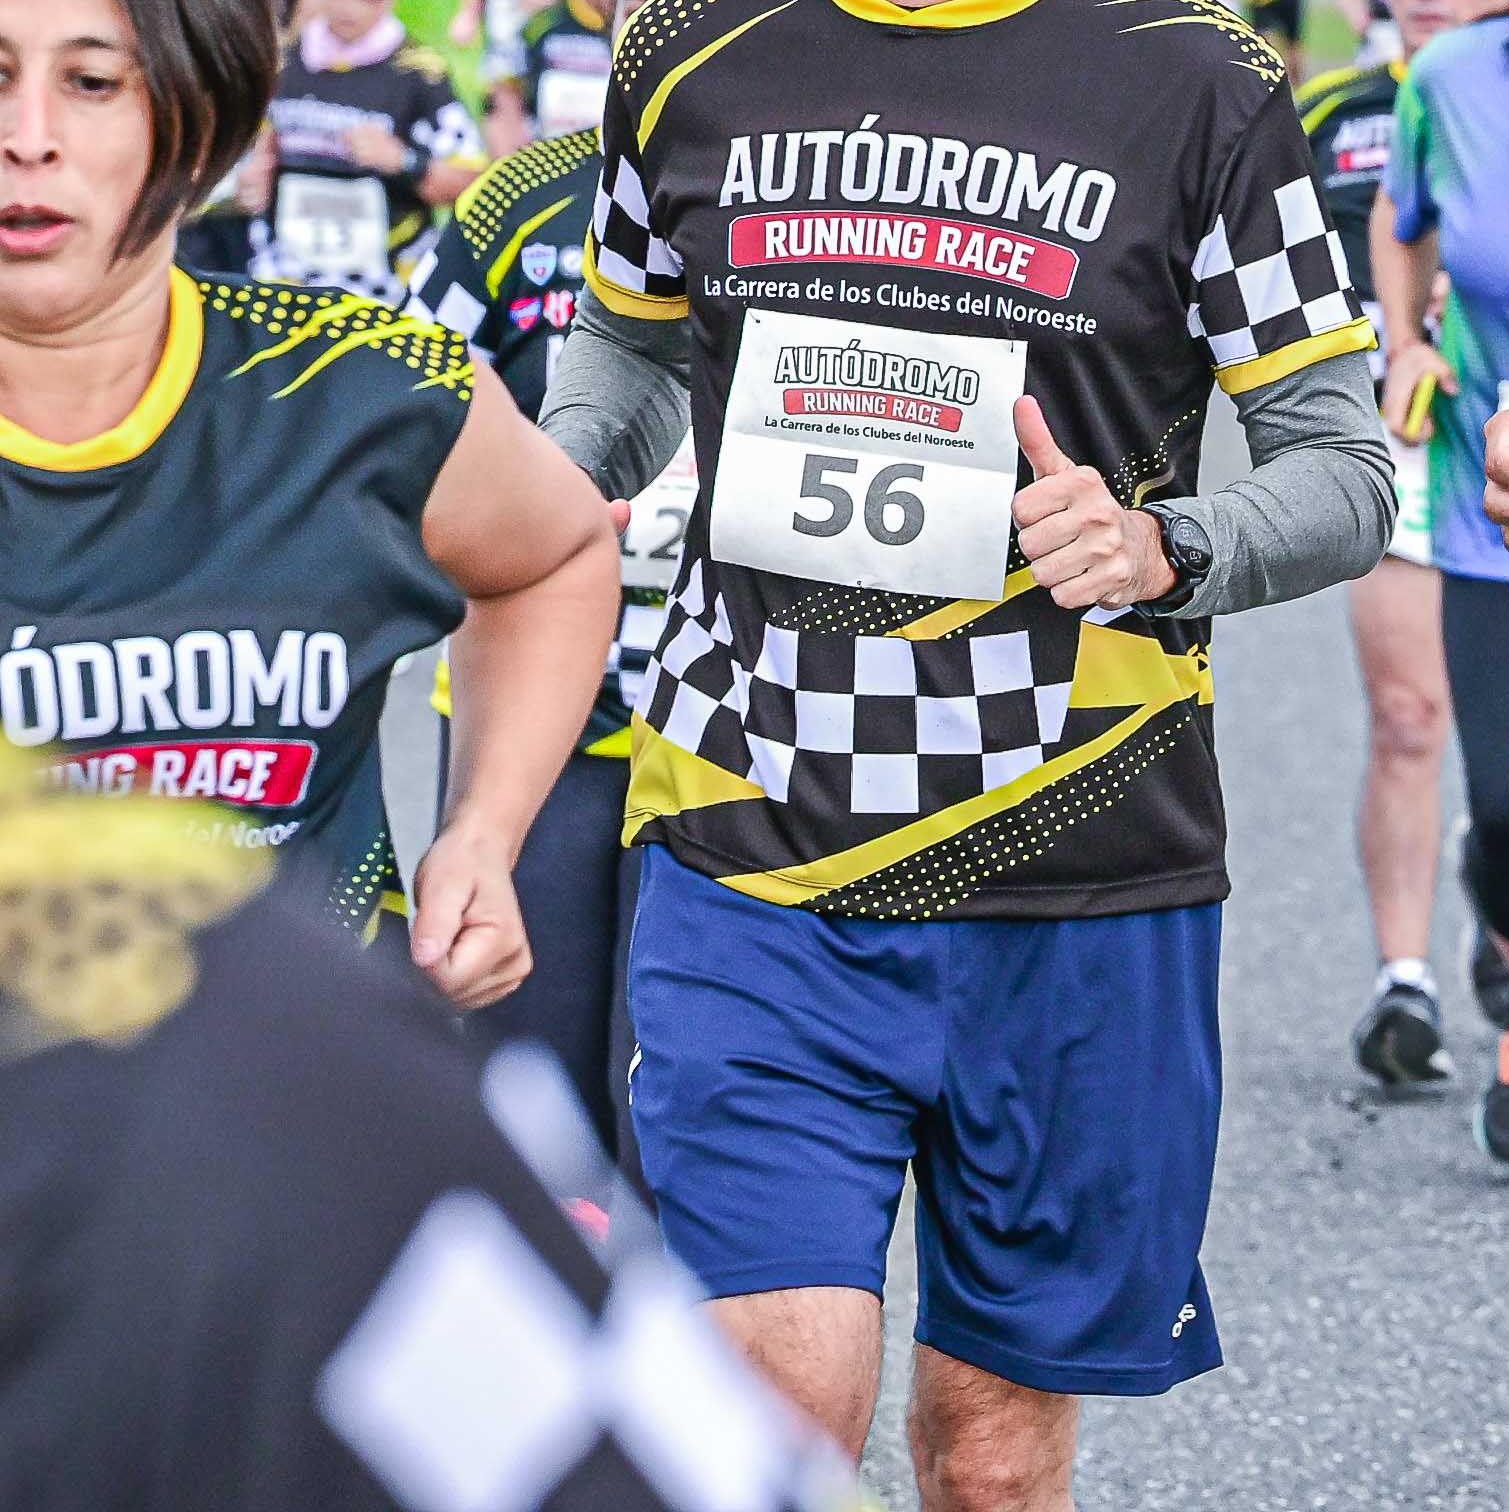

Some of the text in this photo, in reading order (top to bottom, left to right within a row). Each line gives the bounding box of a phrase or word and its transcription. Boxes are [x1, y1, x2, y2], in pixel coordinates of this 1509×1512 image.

[718, 113, 1117, 243] AUTÓDROMO
[764, 217, 1036, 283] RUNNING RACE
[703, 274, 1097, 335] La Carrera de los Clubes del Noroeste
[773, 338, 980, 406] AUTÓDROMO
[764, 415, 975, 450] La Carrera de los Clubes del Noroeste
[803, 391, 942, 427] RUNNING RACE
[792, 453, 925, 546] 56
[0, 625, 350, 747] ÓDROMO
[151, 748, 278, 801] RACE
